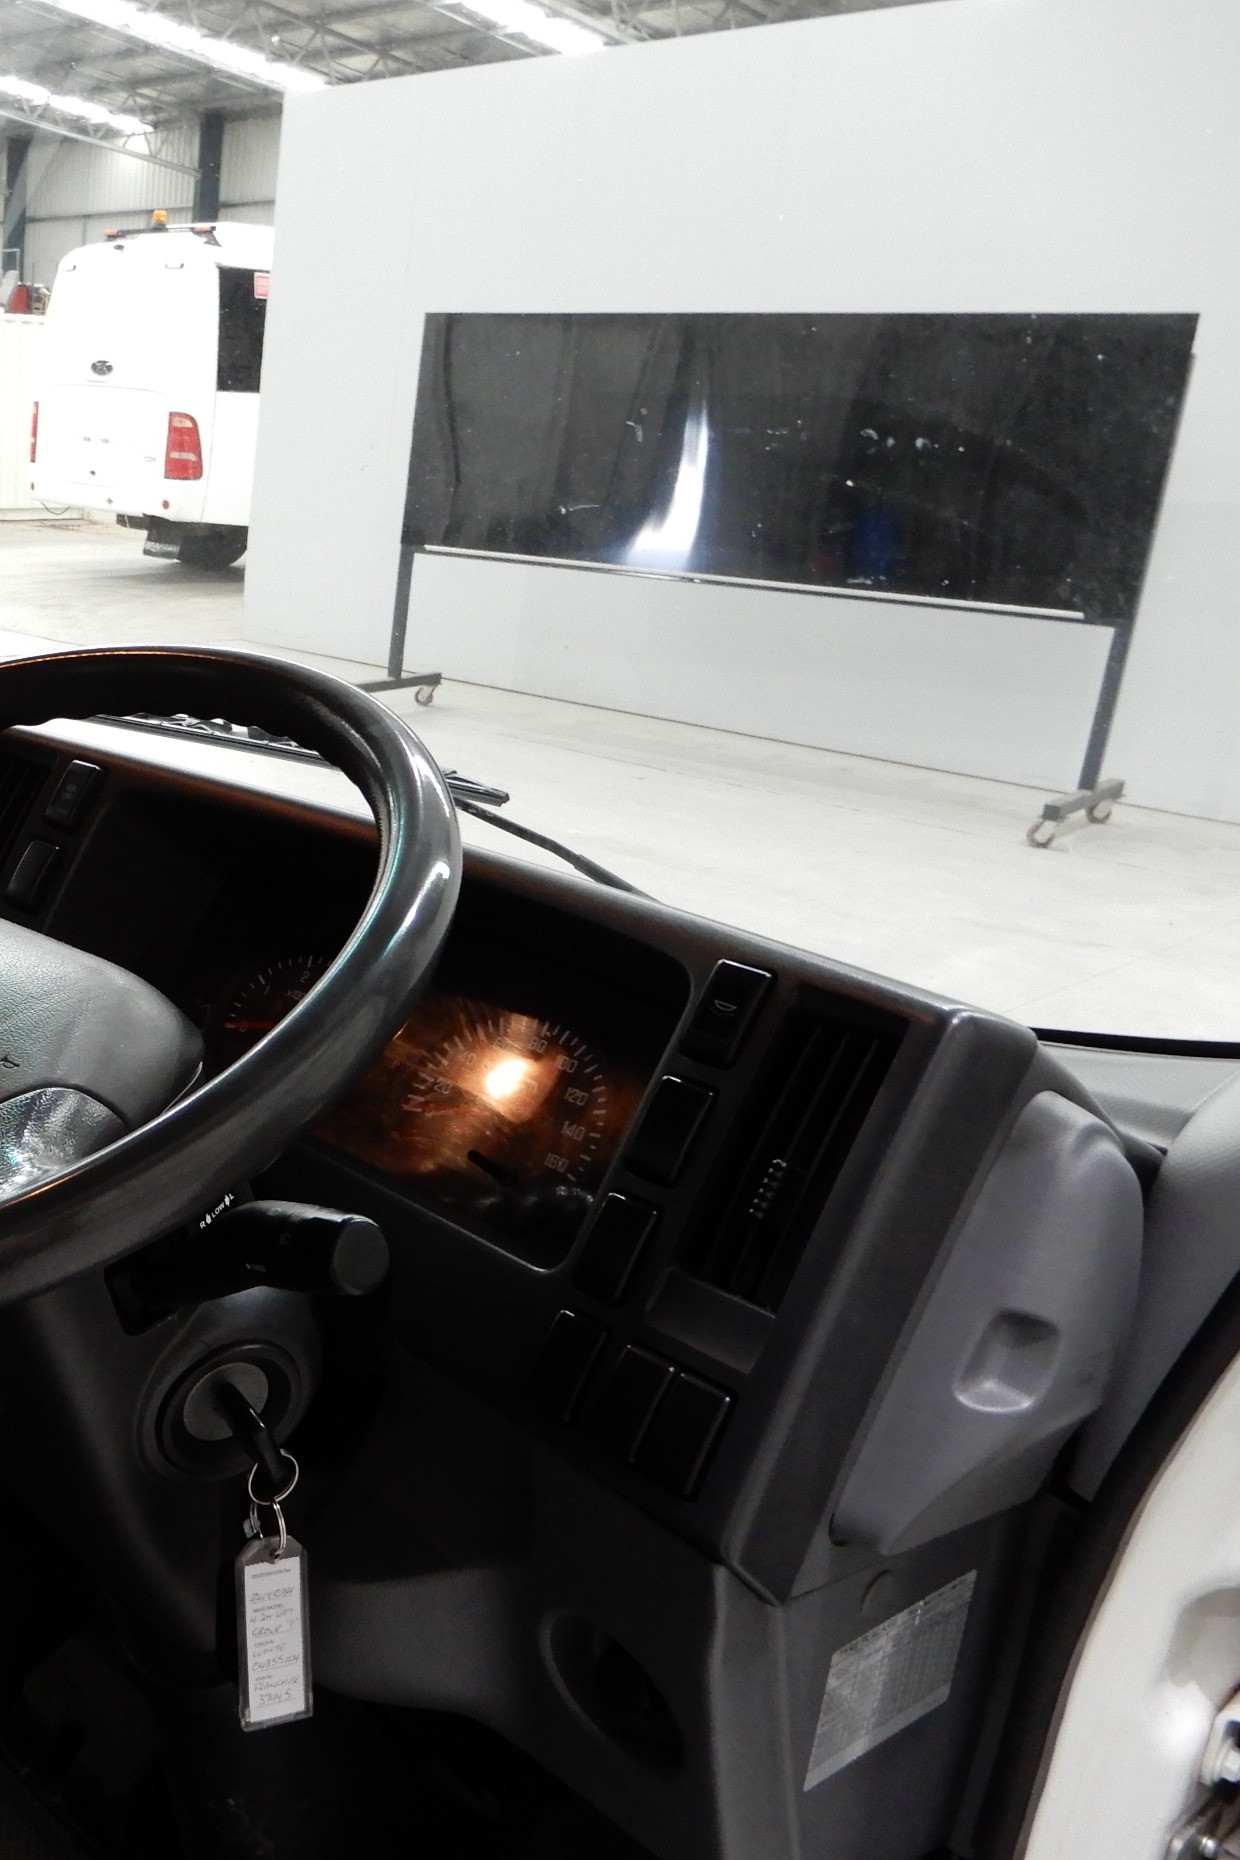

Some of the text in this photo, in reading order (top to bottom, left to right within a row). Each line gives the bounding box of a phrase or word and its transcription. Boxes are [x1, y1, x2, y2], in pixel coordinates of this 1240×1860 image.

[300, 971, 310, 983] 2
[433, 1078, 453, 1095] 20
[563, 1087, 589, 1106] 120
[561, 1121, 586, 1142] 140
[544, 1153, 569, 1173] 160
[211, 1202, 225, 1218] LOW
